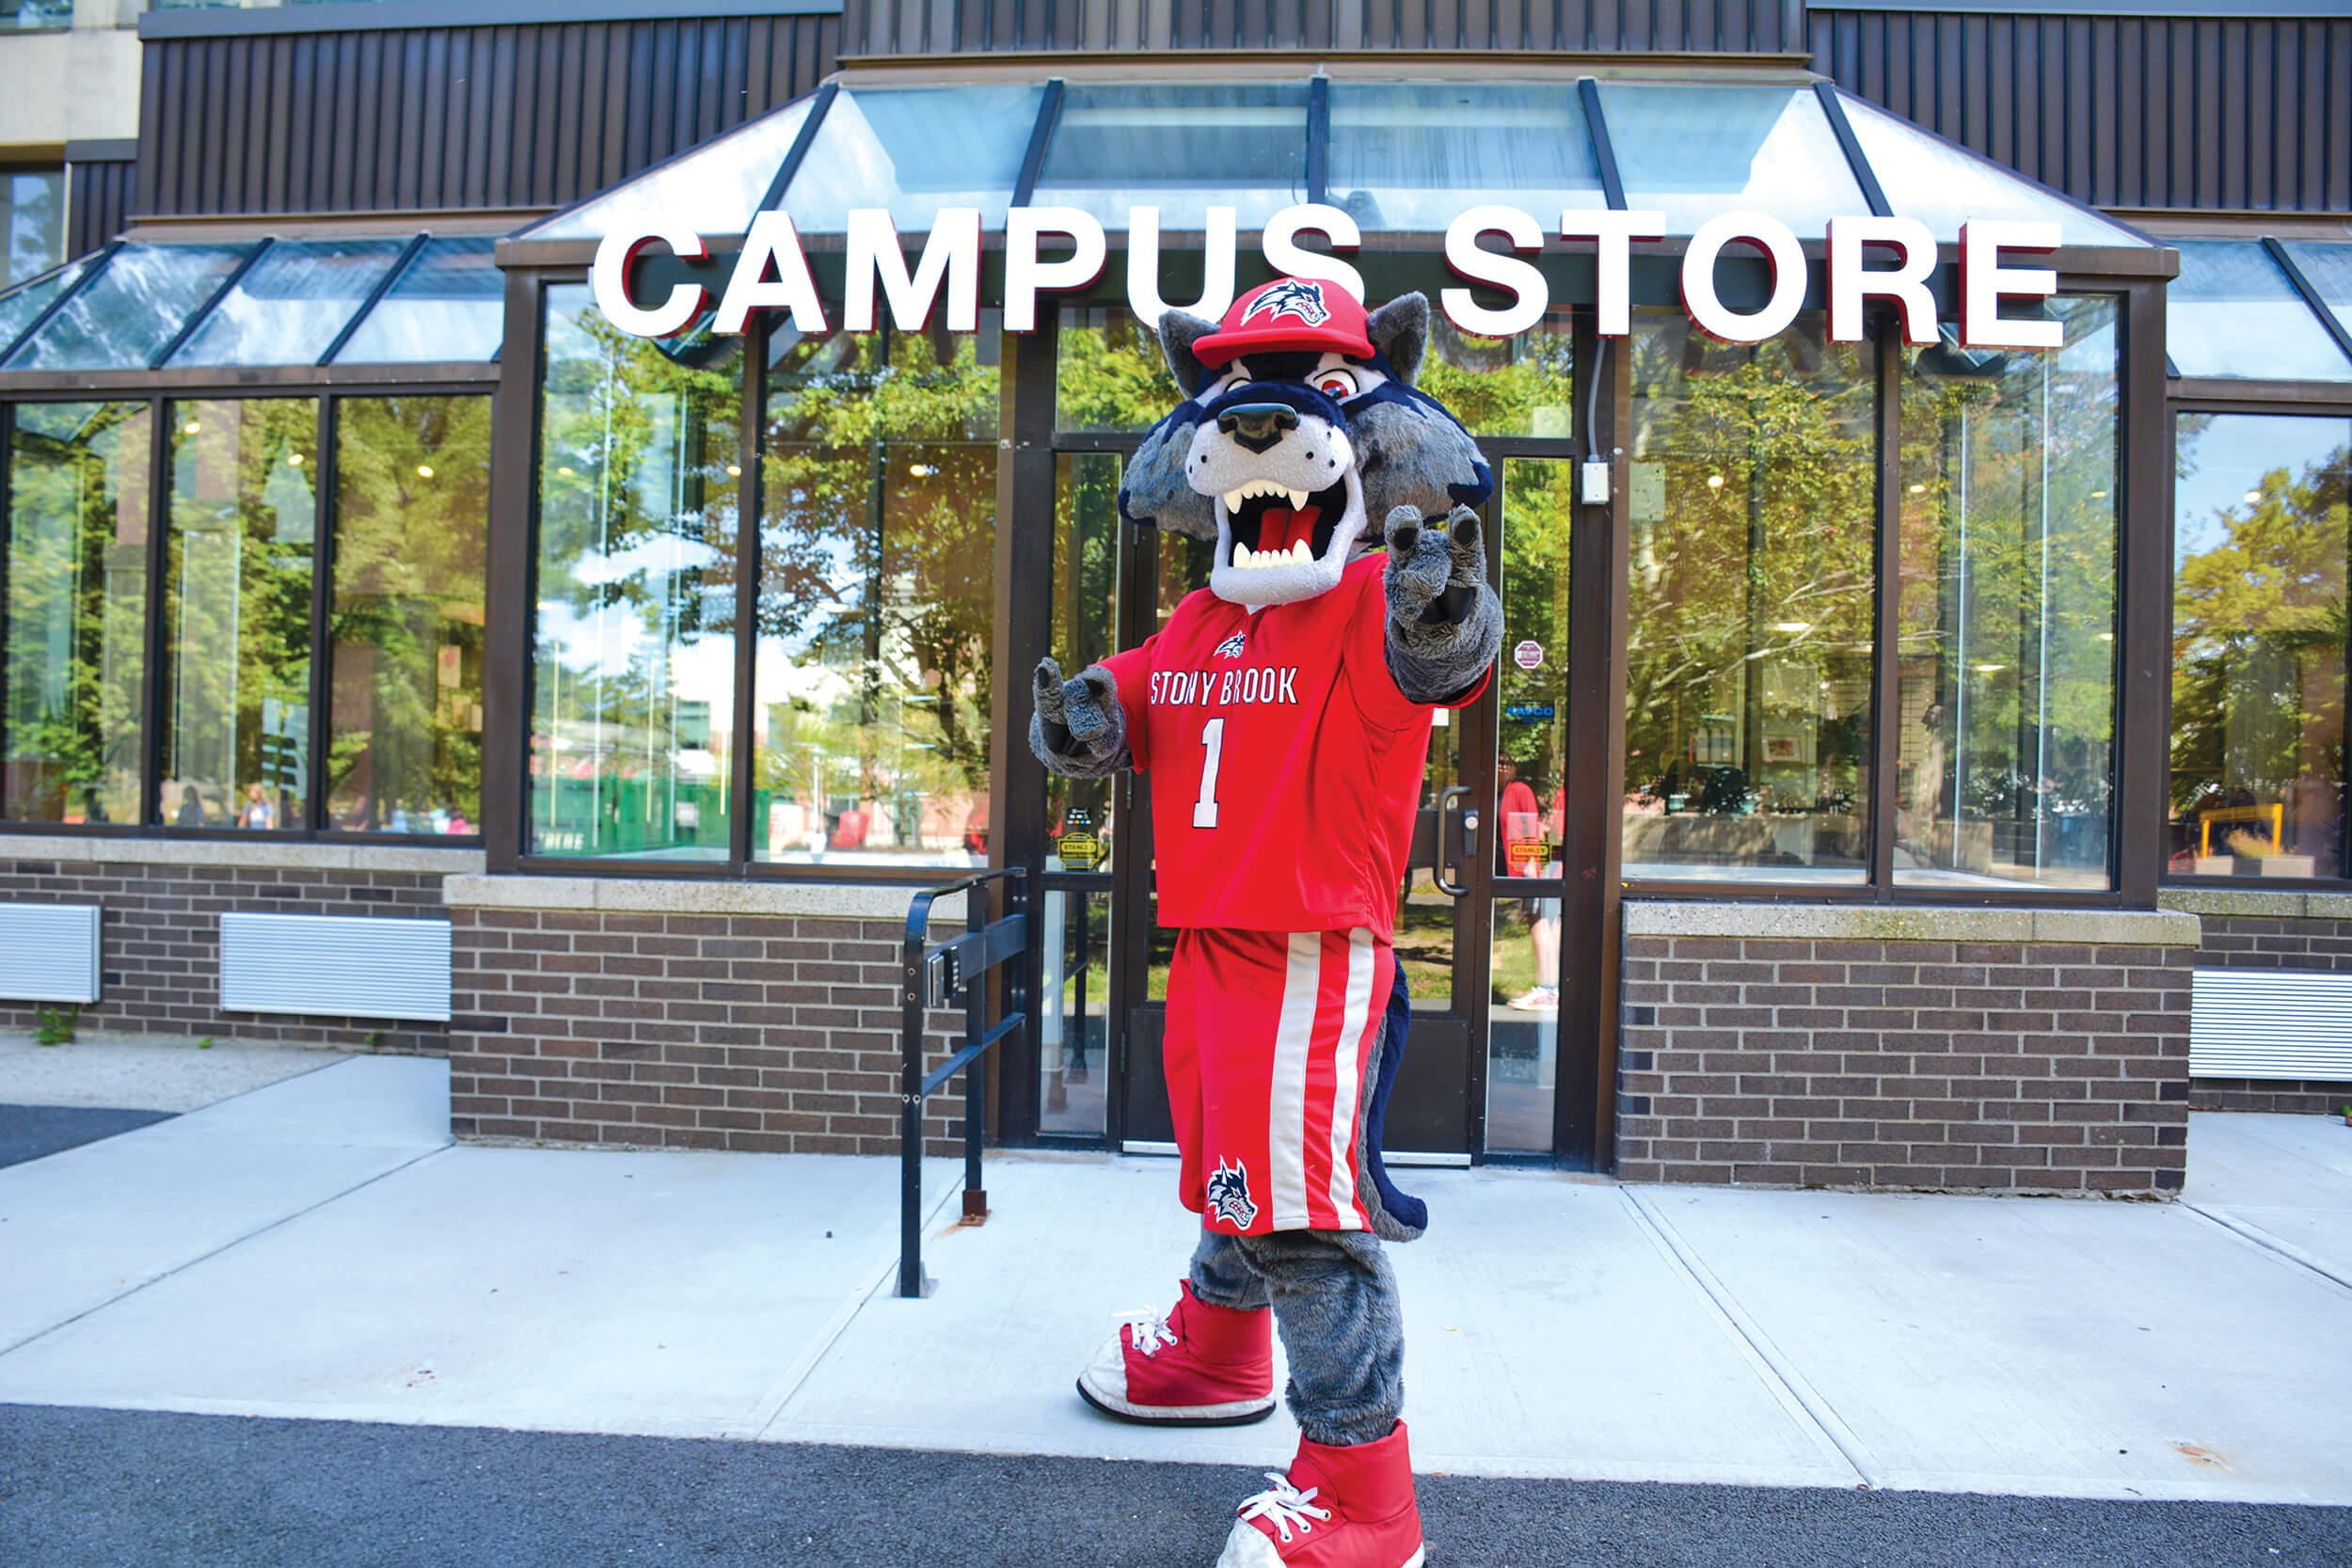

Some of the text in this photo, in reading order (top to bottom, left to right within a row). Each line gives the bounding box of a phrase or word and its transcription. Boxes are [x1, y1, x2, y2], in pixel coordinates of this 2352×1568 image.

[592, 203, 2065, 349] CAMPUS STORE
[1151, 666, 1299, 705] STONY BROOK
[1192, 717, 1225, 829] 1
